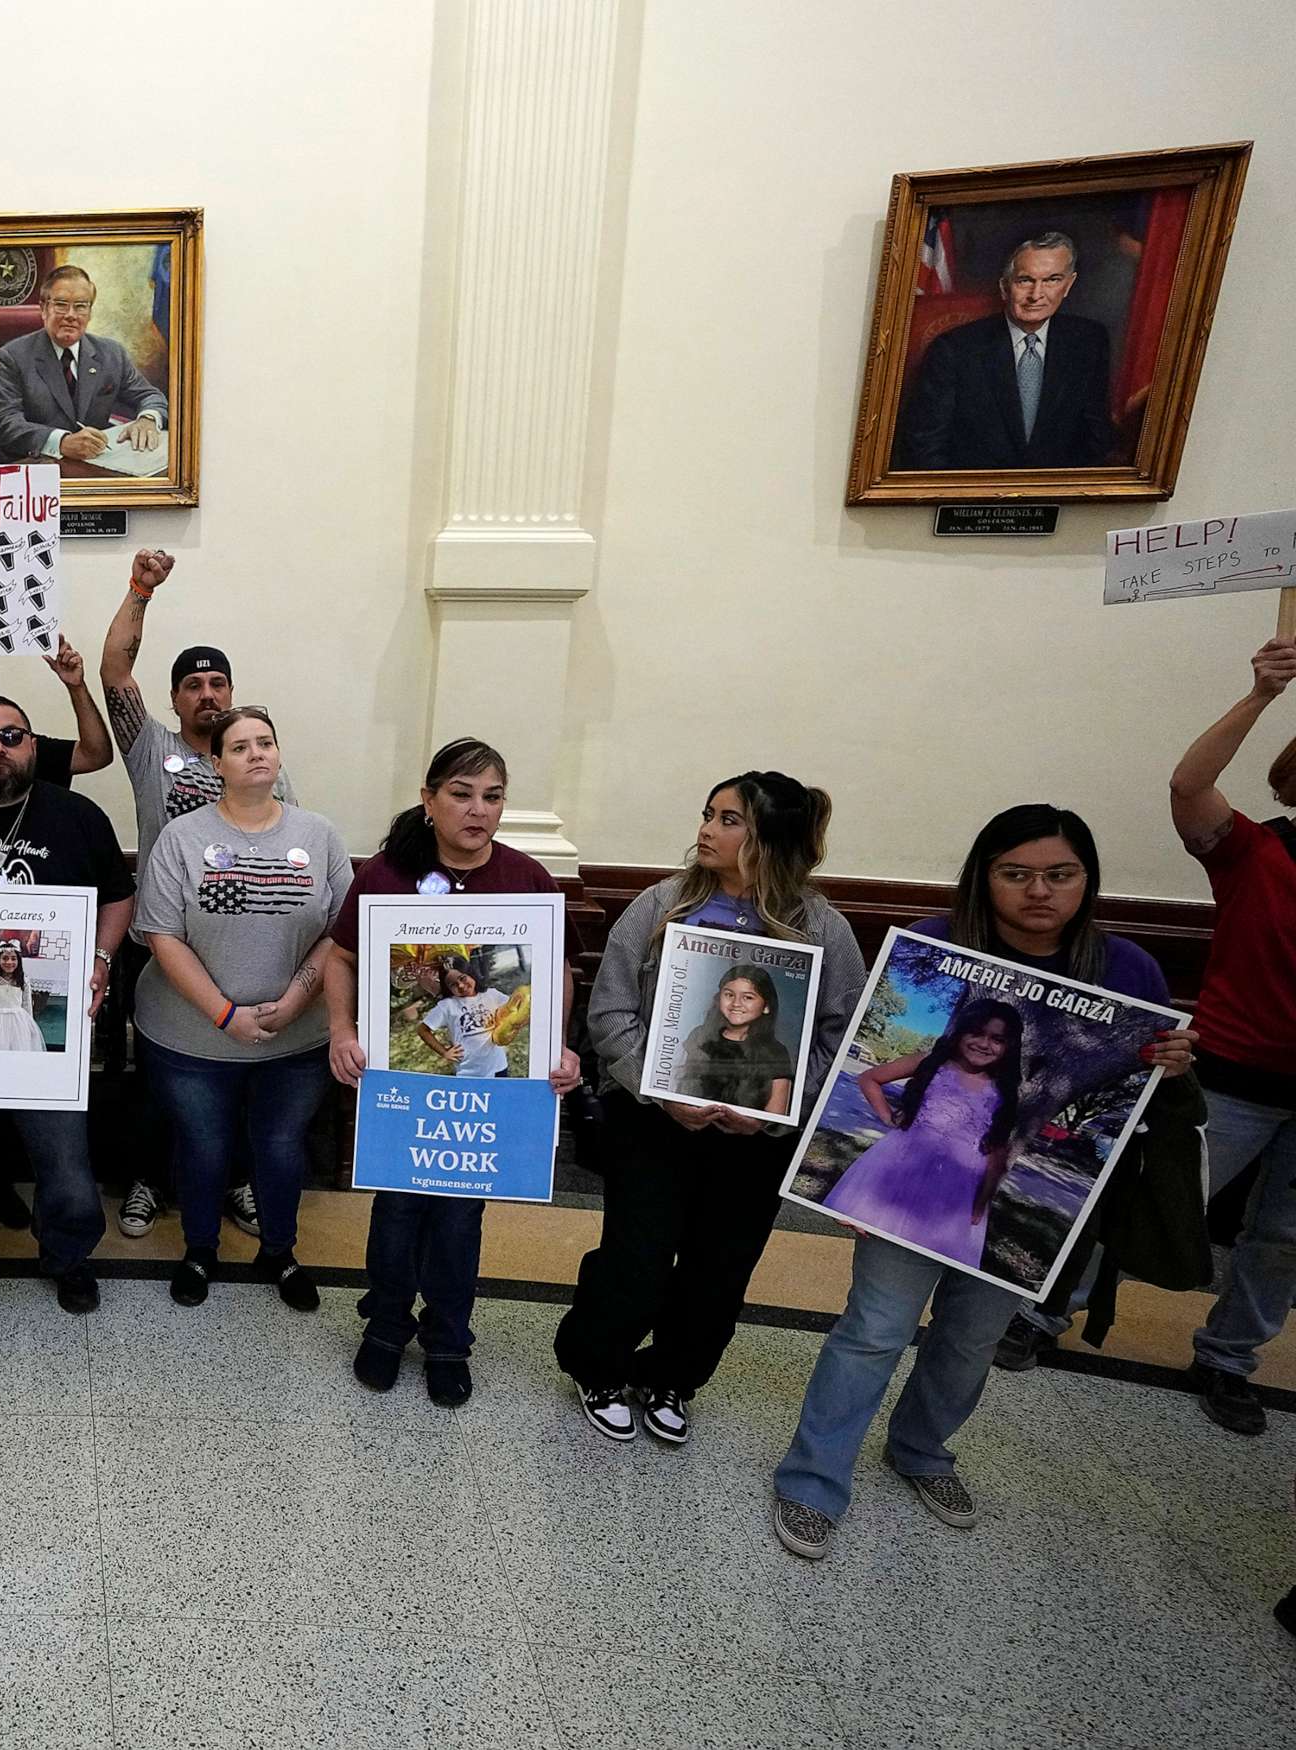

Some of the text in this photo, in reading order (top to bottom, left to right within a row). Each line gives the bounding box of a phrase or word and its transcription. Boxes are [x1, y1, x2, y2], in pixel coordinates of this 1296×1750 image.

[1114, 518, 1238, 556] HELP!
[1119, 547, 1280, 590] TAKE STEPS TO
[196, 659, 210, 669] UZI
[14, 840, 50, 859] Hearts
[0, 909, 45, 922] Cazares,
[48, 910, 56, 921] 9
[395, 923, 528, 939] Amerie Jo Garza, 10
[676, 934, 807, 971] Amerie Garza
[937, 956, 1116, 1025] AMERIE JO GARZA
[663, 983, 689, 1031] Memory
[656, 1035, 680, 1076] Loving
[653, 1078, 669, 1090] In
[376, 1093, 410, 1104] TEXAS
[426, 1089, 491, 1113] GUN
[415, 1118, 497, 1144] LAWS
[409, 1146, 499, 1173] WORK
[412, 1176, 493, 1193] txgunsense.org
